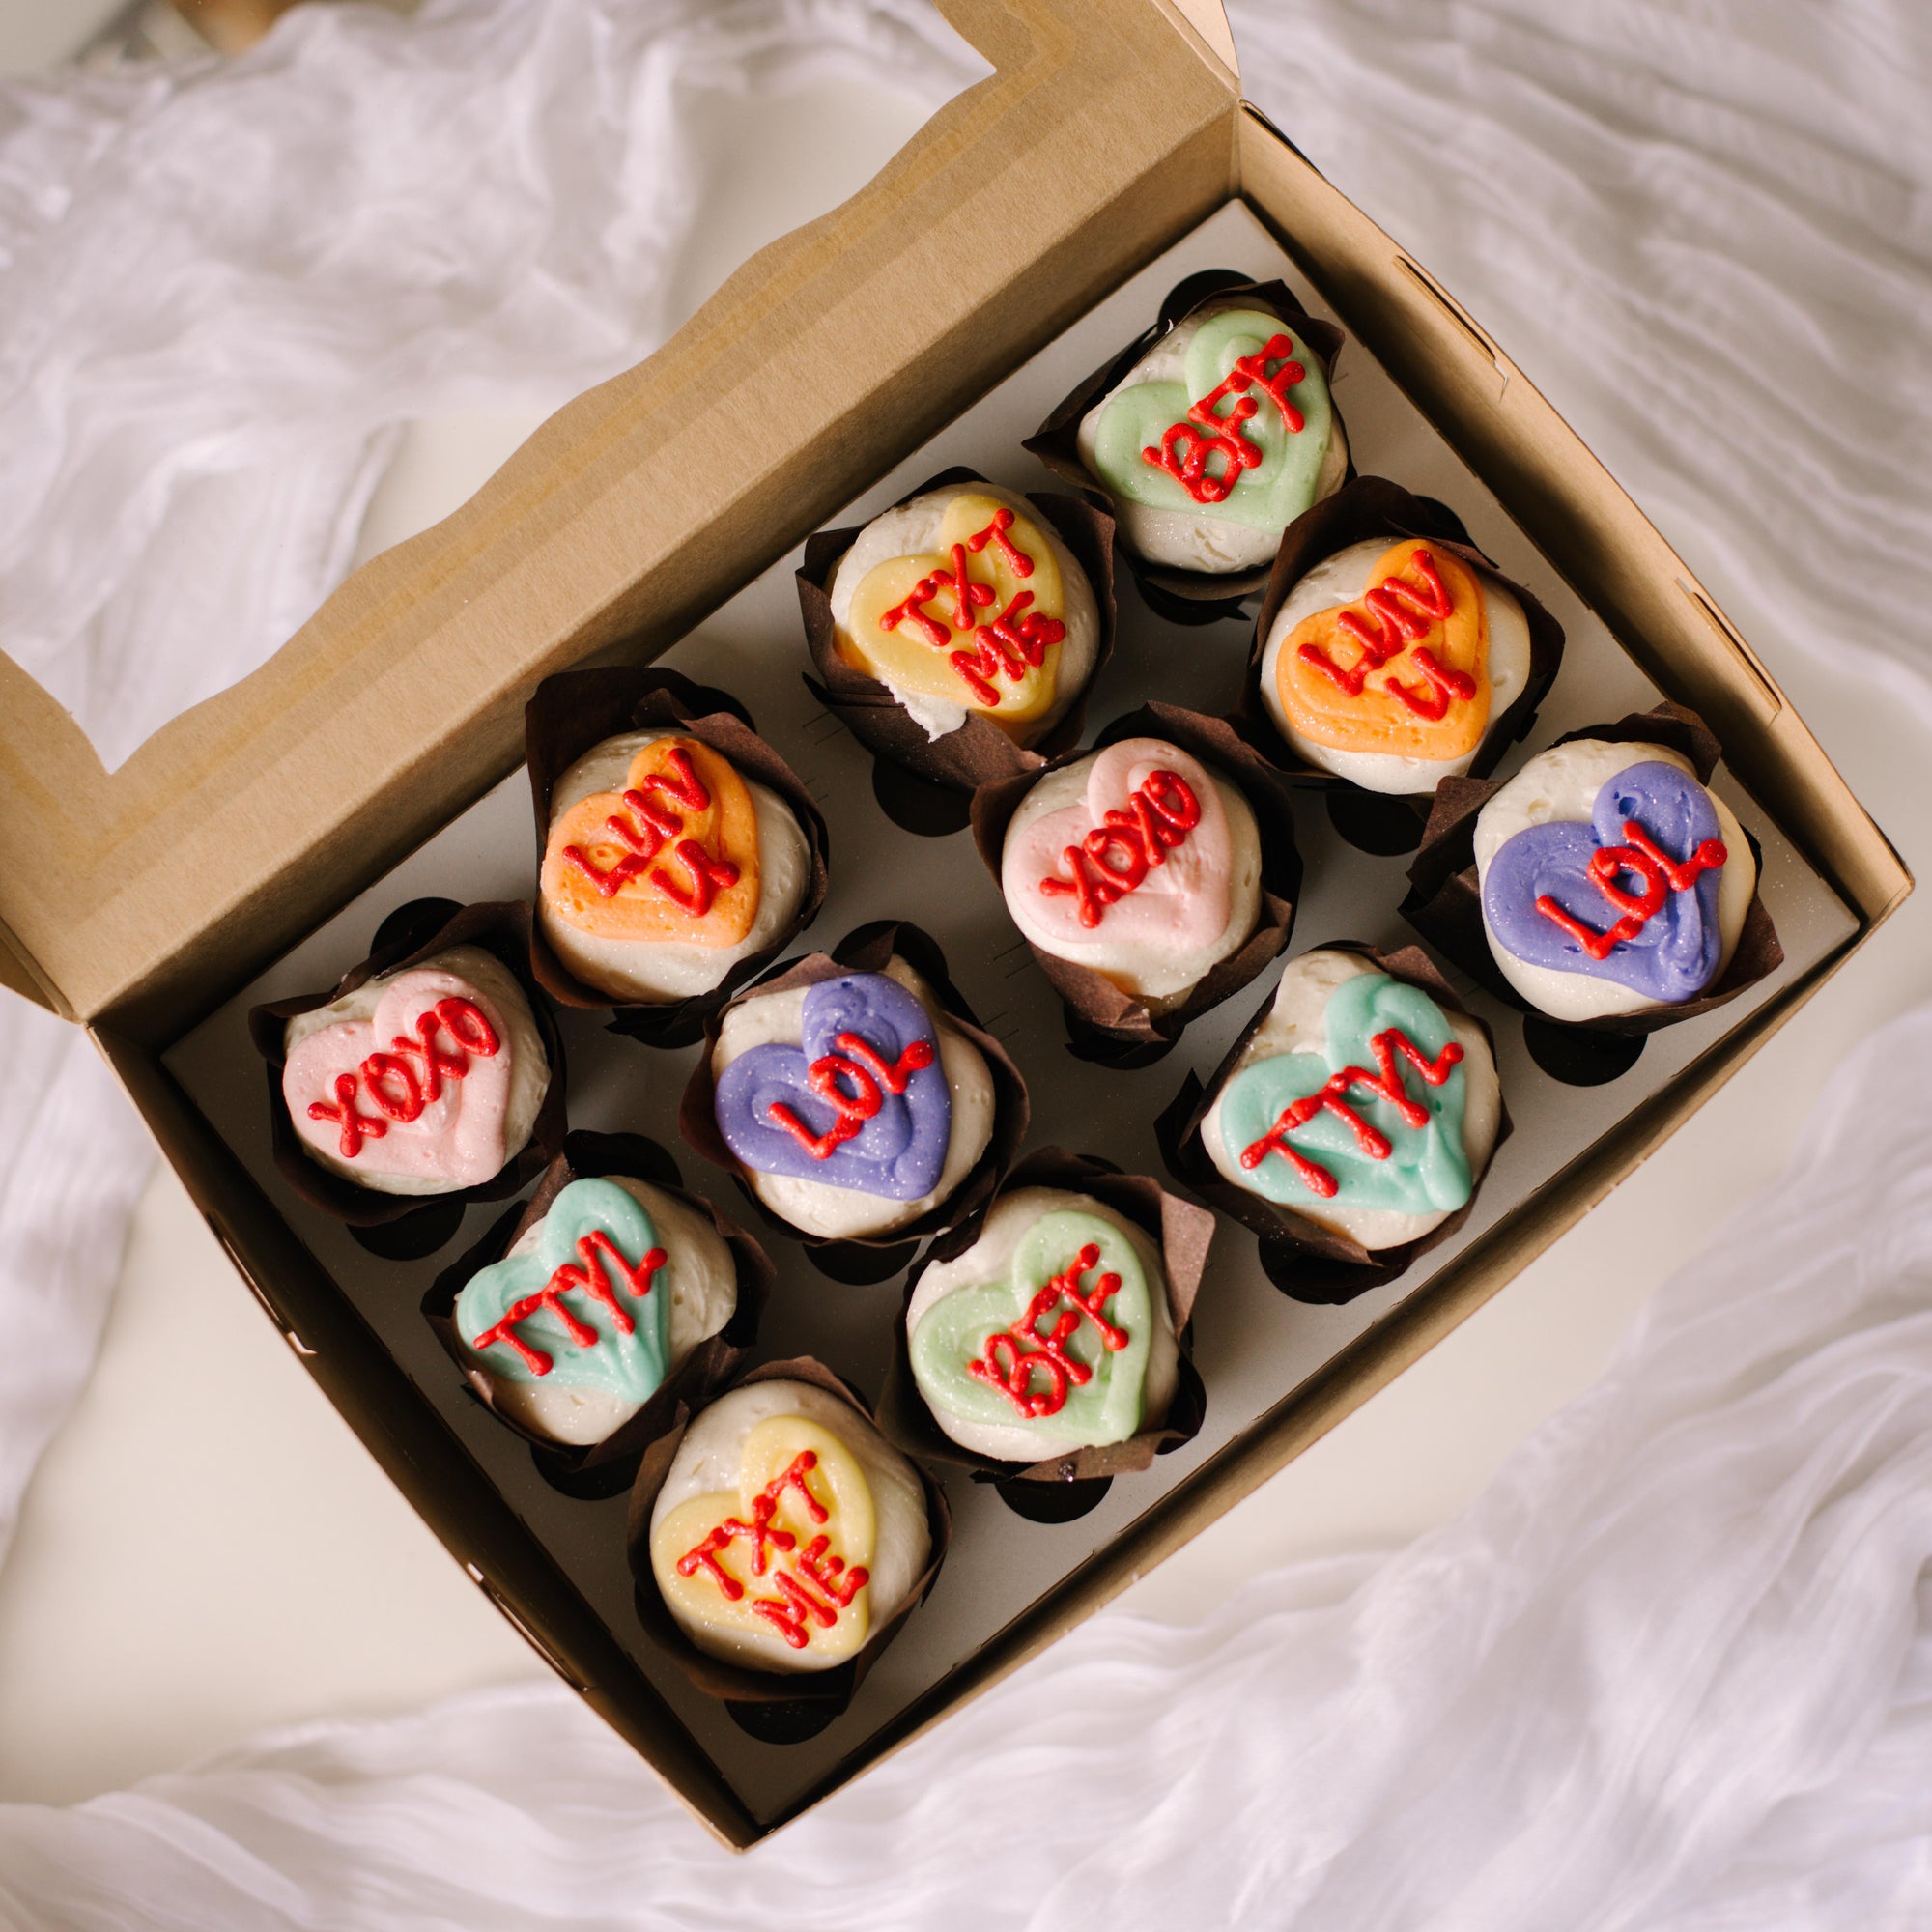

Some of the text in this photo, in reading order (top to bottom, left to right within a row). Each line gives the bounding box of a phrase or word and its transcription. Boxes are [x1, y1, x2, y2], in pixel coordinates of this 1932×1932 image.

[1142, 333, 1306, 504] BFF
[880, 507, 1035, 647] TXT
[948, 589, 1066, 707] ME
[1296, 547, 1456, 698] LUV
[1383, 645, 1478, 723] U
[561, 747, 712, 899] LUV
[650, 838, 742, 919] U
[1038, 769, 1203, 929] XOXO
[1534, 819, 1729, 960] LOL
[306, 995, 501, 1159] XOXO
[766, 1031, 936, 1160] LOL
[965, 1242, 1130, 1419] BFF
[676, 1449, 829, 1601] TXT
[752, 1534, 870, 1650] ME
